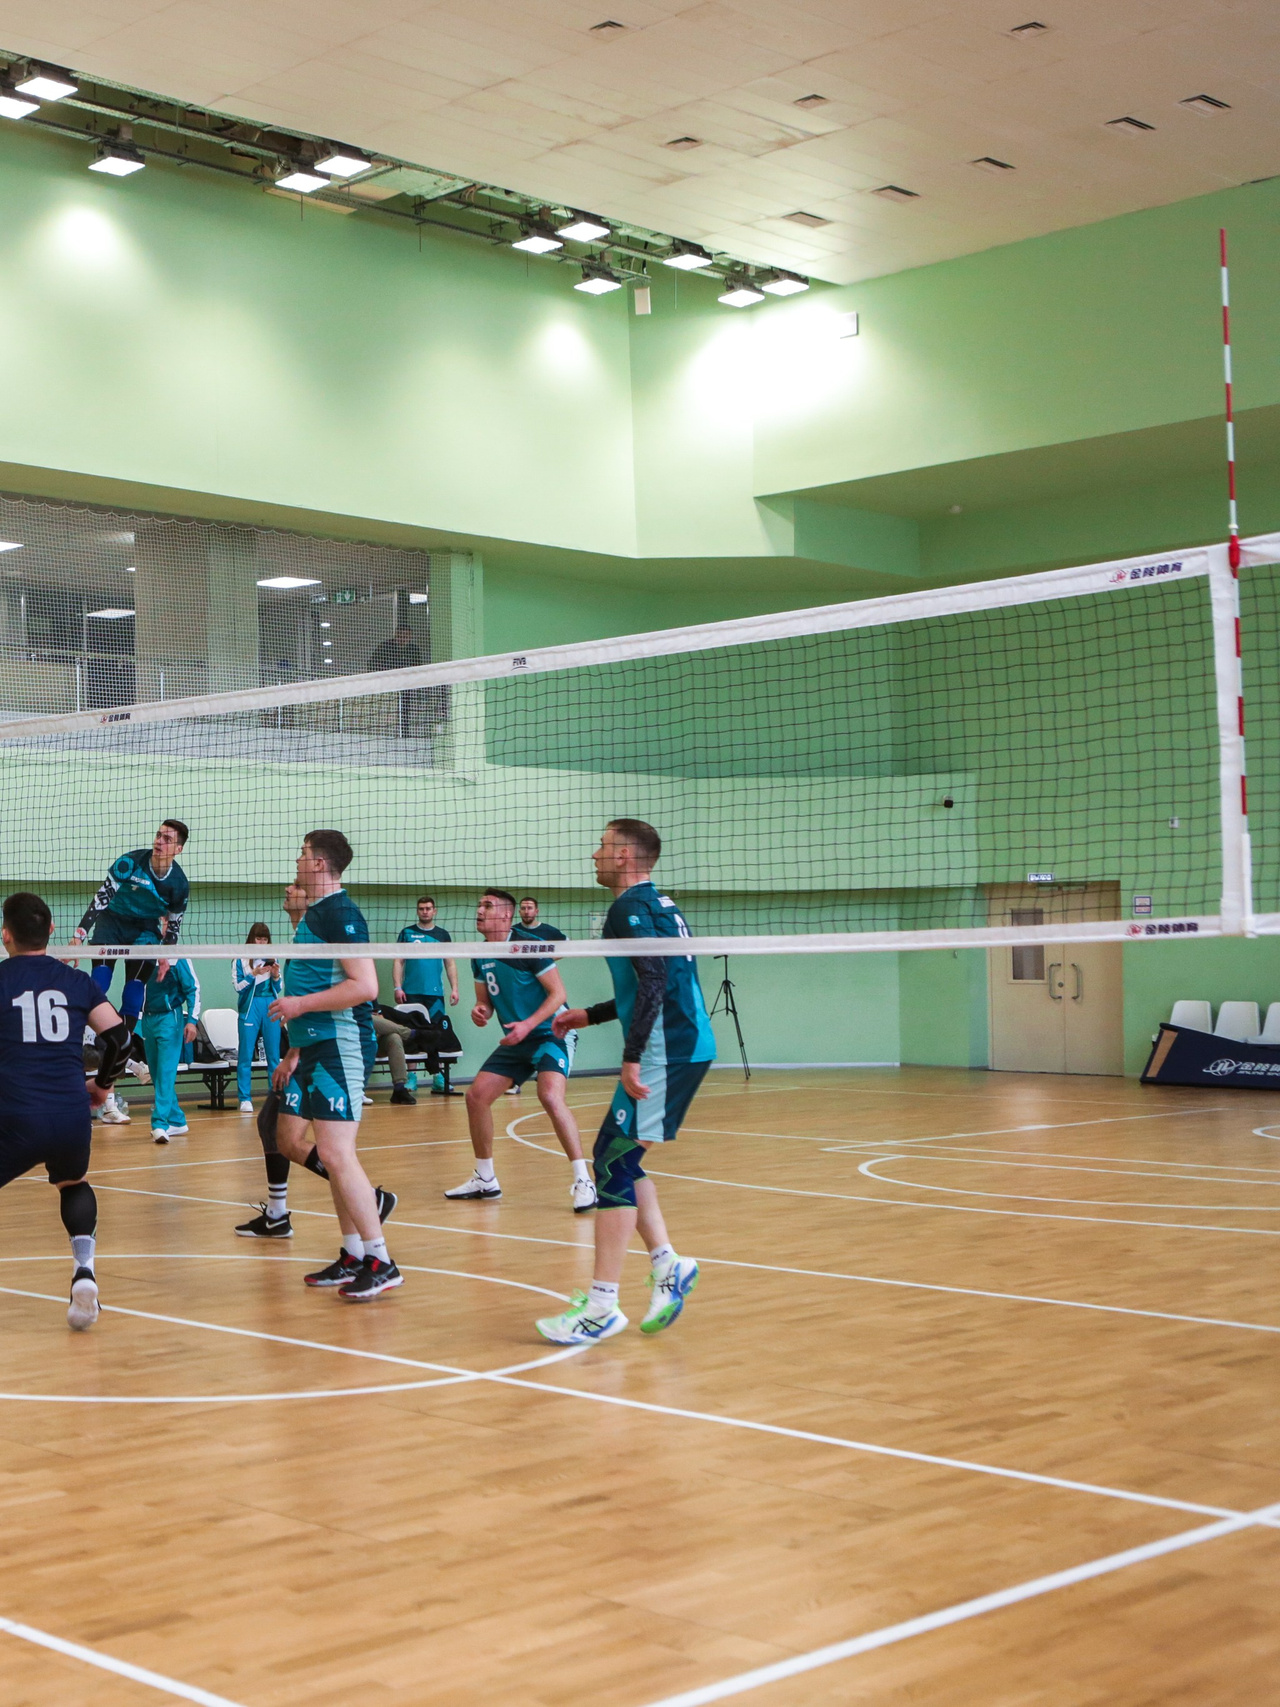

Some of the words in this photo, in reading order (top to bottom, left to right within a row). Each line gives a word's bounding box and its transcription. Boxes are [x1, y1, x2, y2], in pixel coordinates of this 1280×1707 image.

[486, 972, 500, 996] 8
[12, 989, 70, 1043] 16
[558, 1058, 566, 1069] 8
[285, 1093, 300, 1107] 12
[328, 1096, 345, 1112] 14
[616, 1109, 627, 1125] 9
